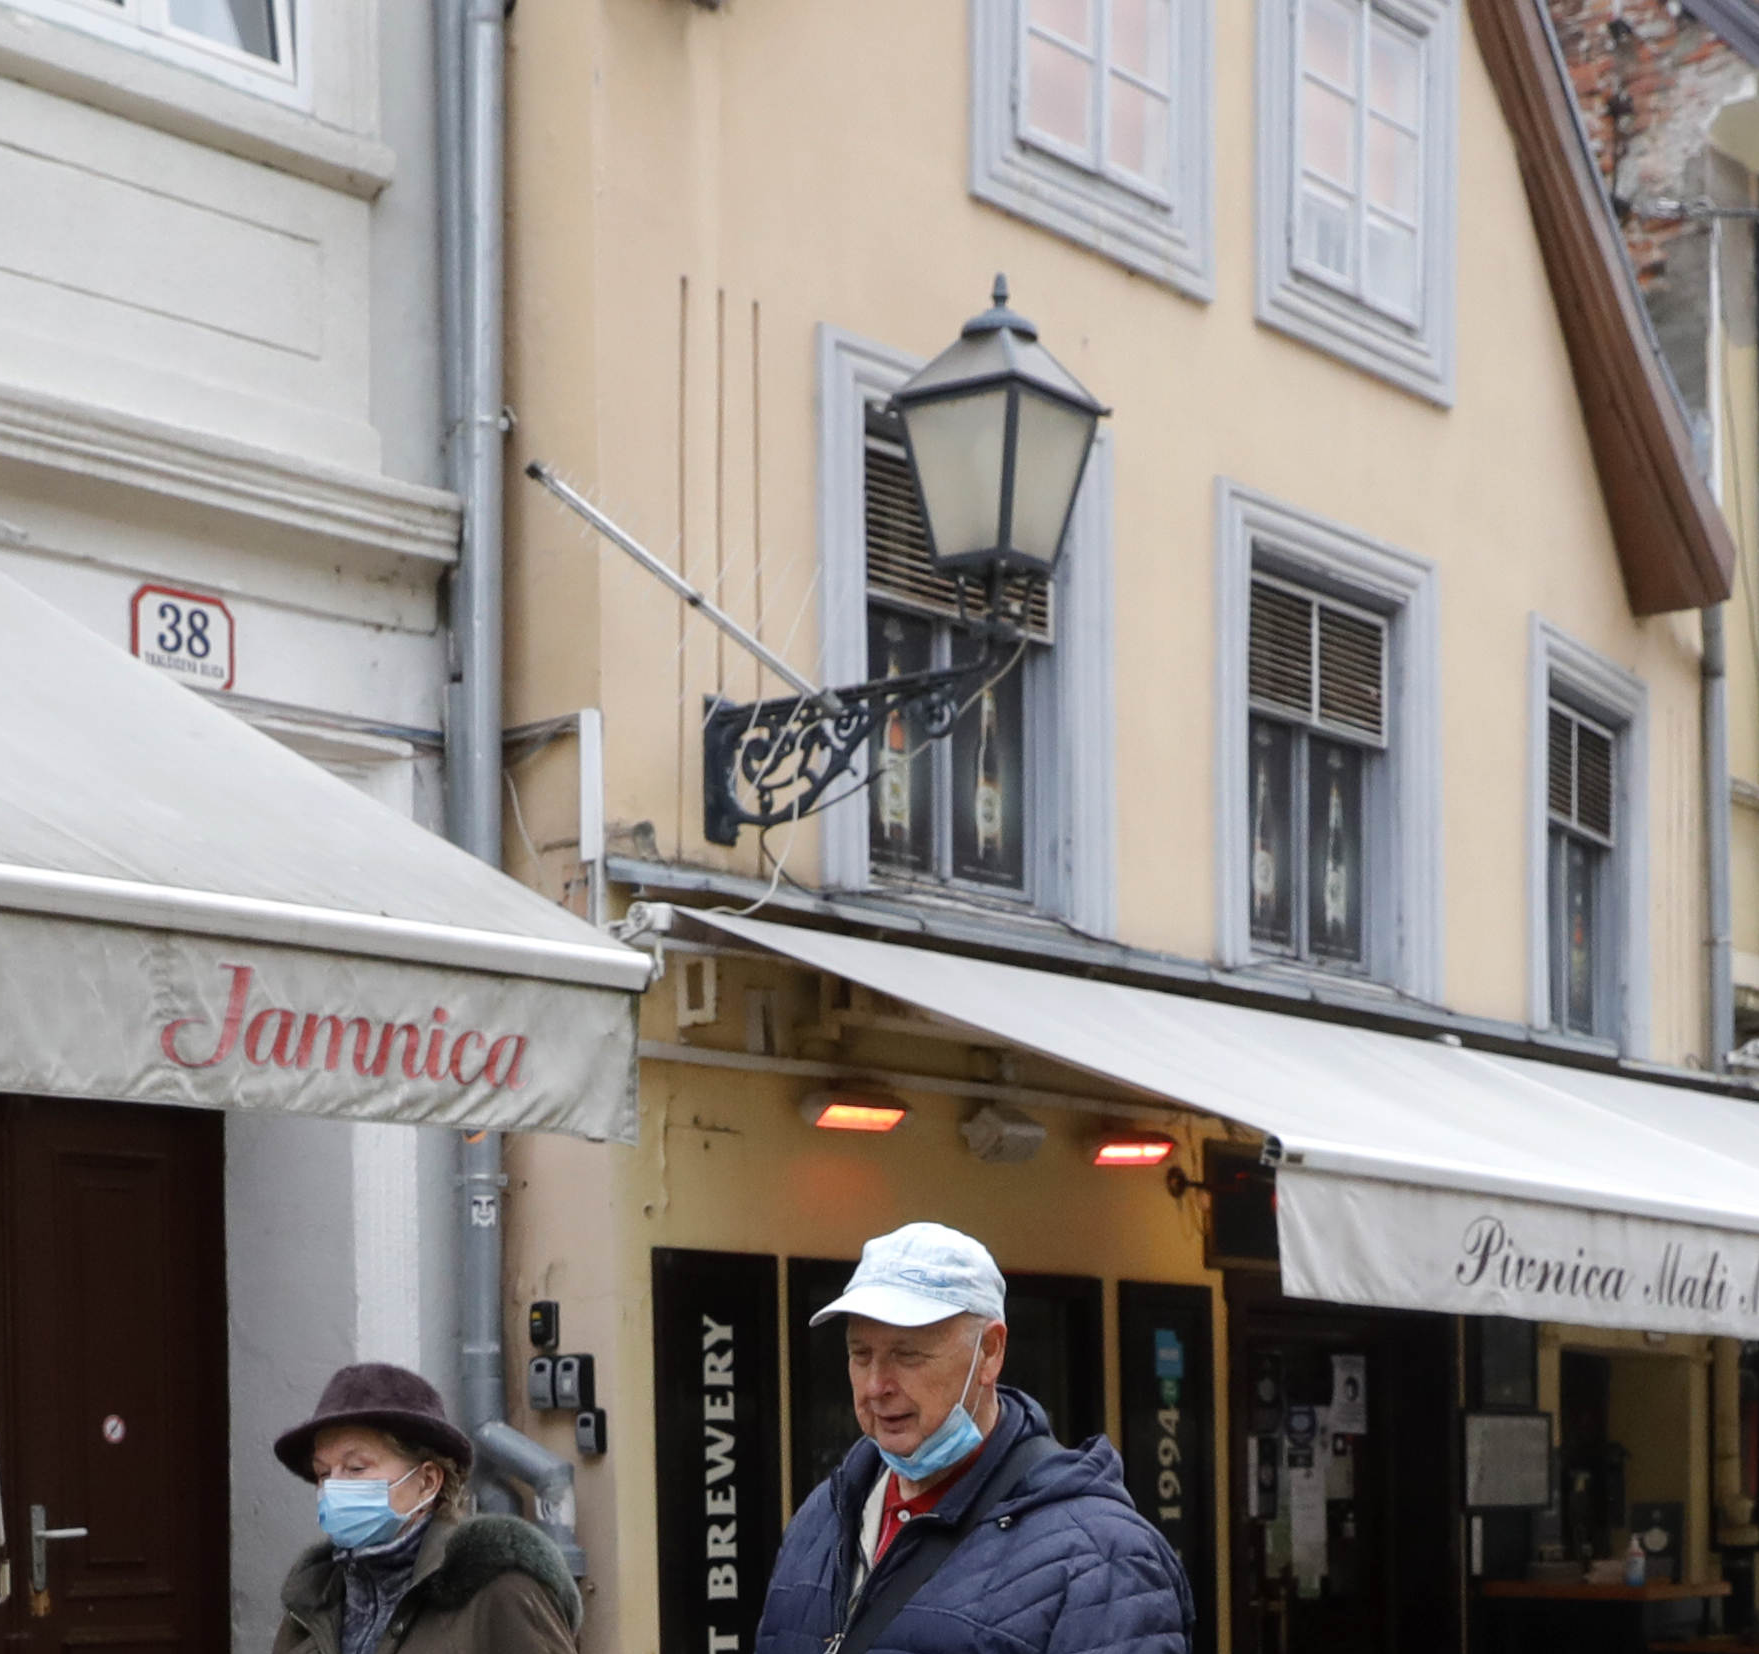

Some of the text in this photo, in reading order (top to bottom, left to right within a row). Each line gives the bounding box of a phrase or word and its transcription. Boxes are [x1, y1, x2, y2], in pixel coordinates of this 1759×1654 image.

[157, 602, 210, 658] 38
[160, 962, 532, 1091] Jamnica
[1455, 1214, 1630, 1302] Pivnica
[1643, 1241, 1730, 1311] Mali
[702, 1314, 740, 1600] BREWERY
[1157, 1404, 1183, 1522] 1994
